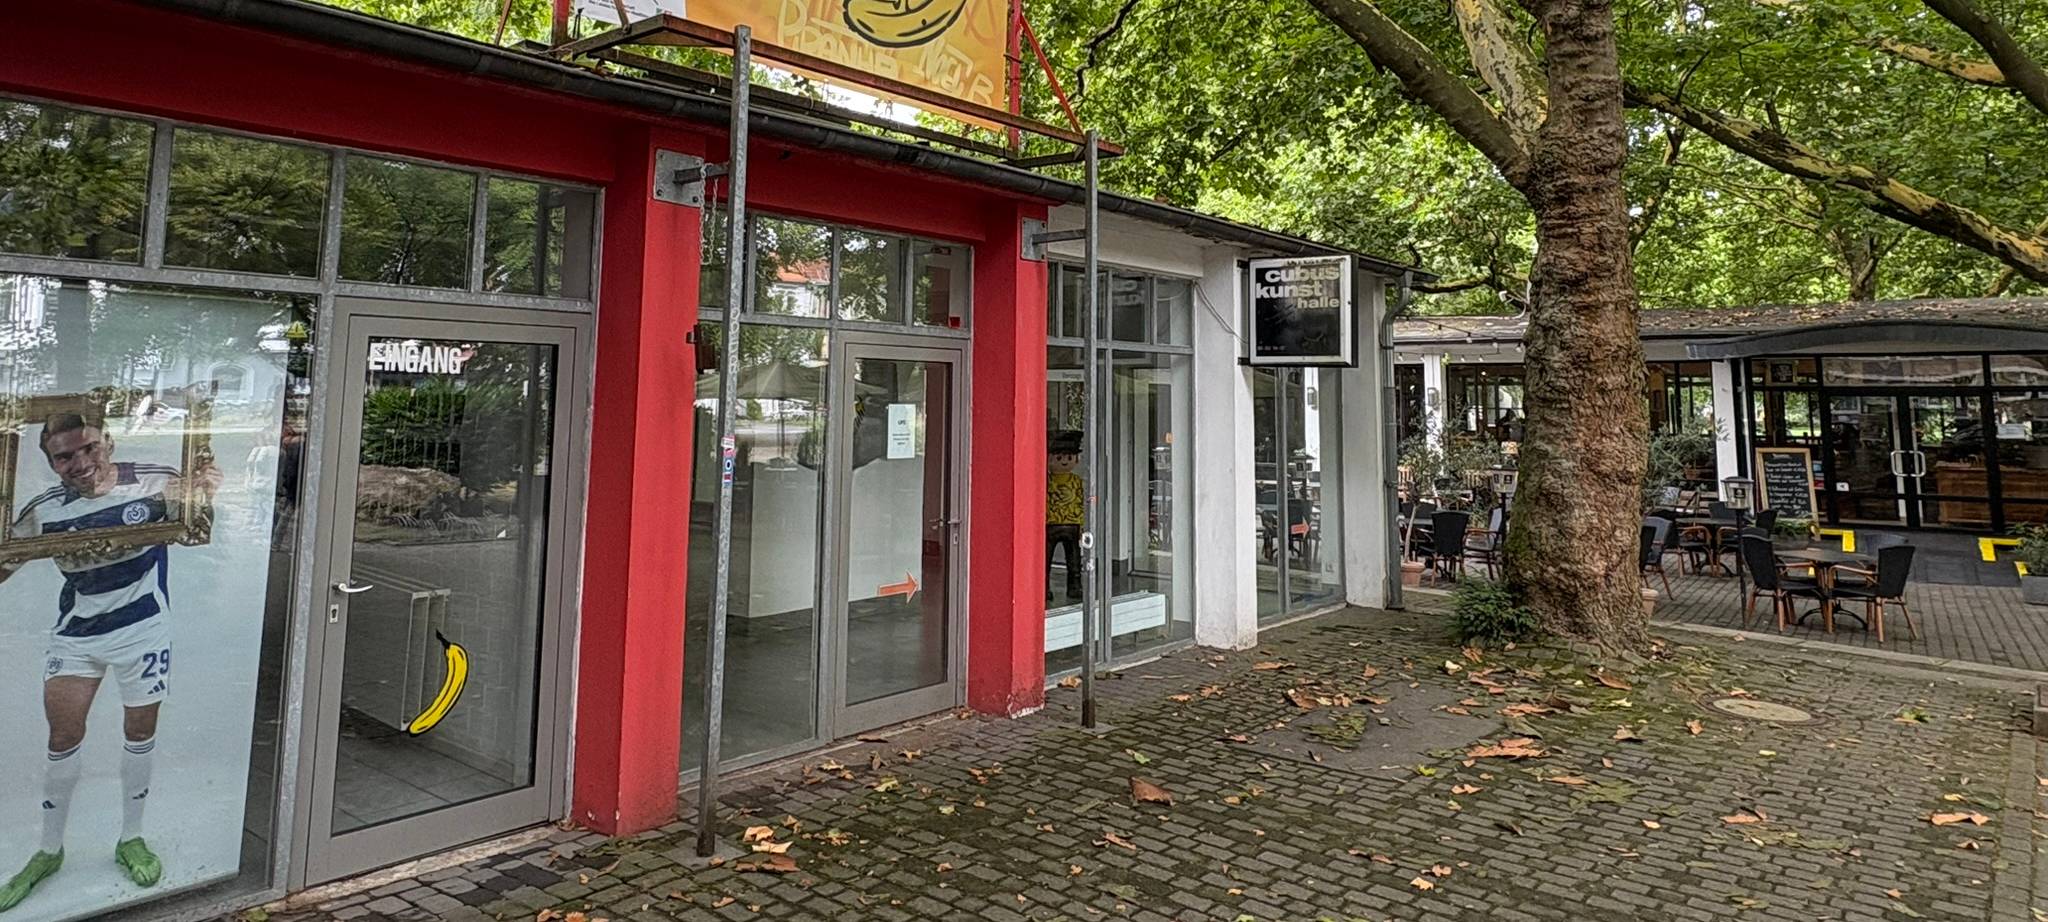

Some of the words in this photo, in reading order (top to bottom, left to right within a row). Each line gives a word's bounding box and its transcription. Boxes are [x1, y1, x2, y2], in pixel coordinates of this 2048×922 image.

[1265, 266, 1340, 283] cubus
[1256, 280, 1323, 299] kunst
[1297, 296, 1340, 309] halle
[368, 342, 462, 375] EINGANG
[140, 648, 170, 679] 29
